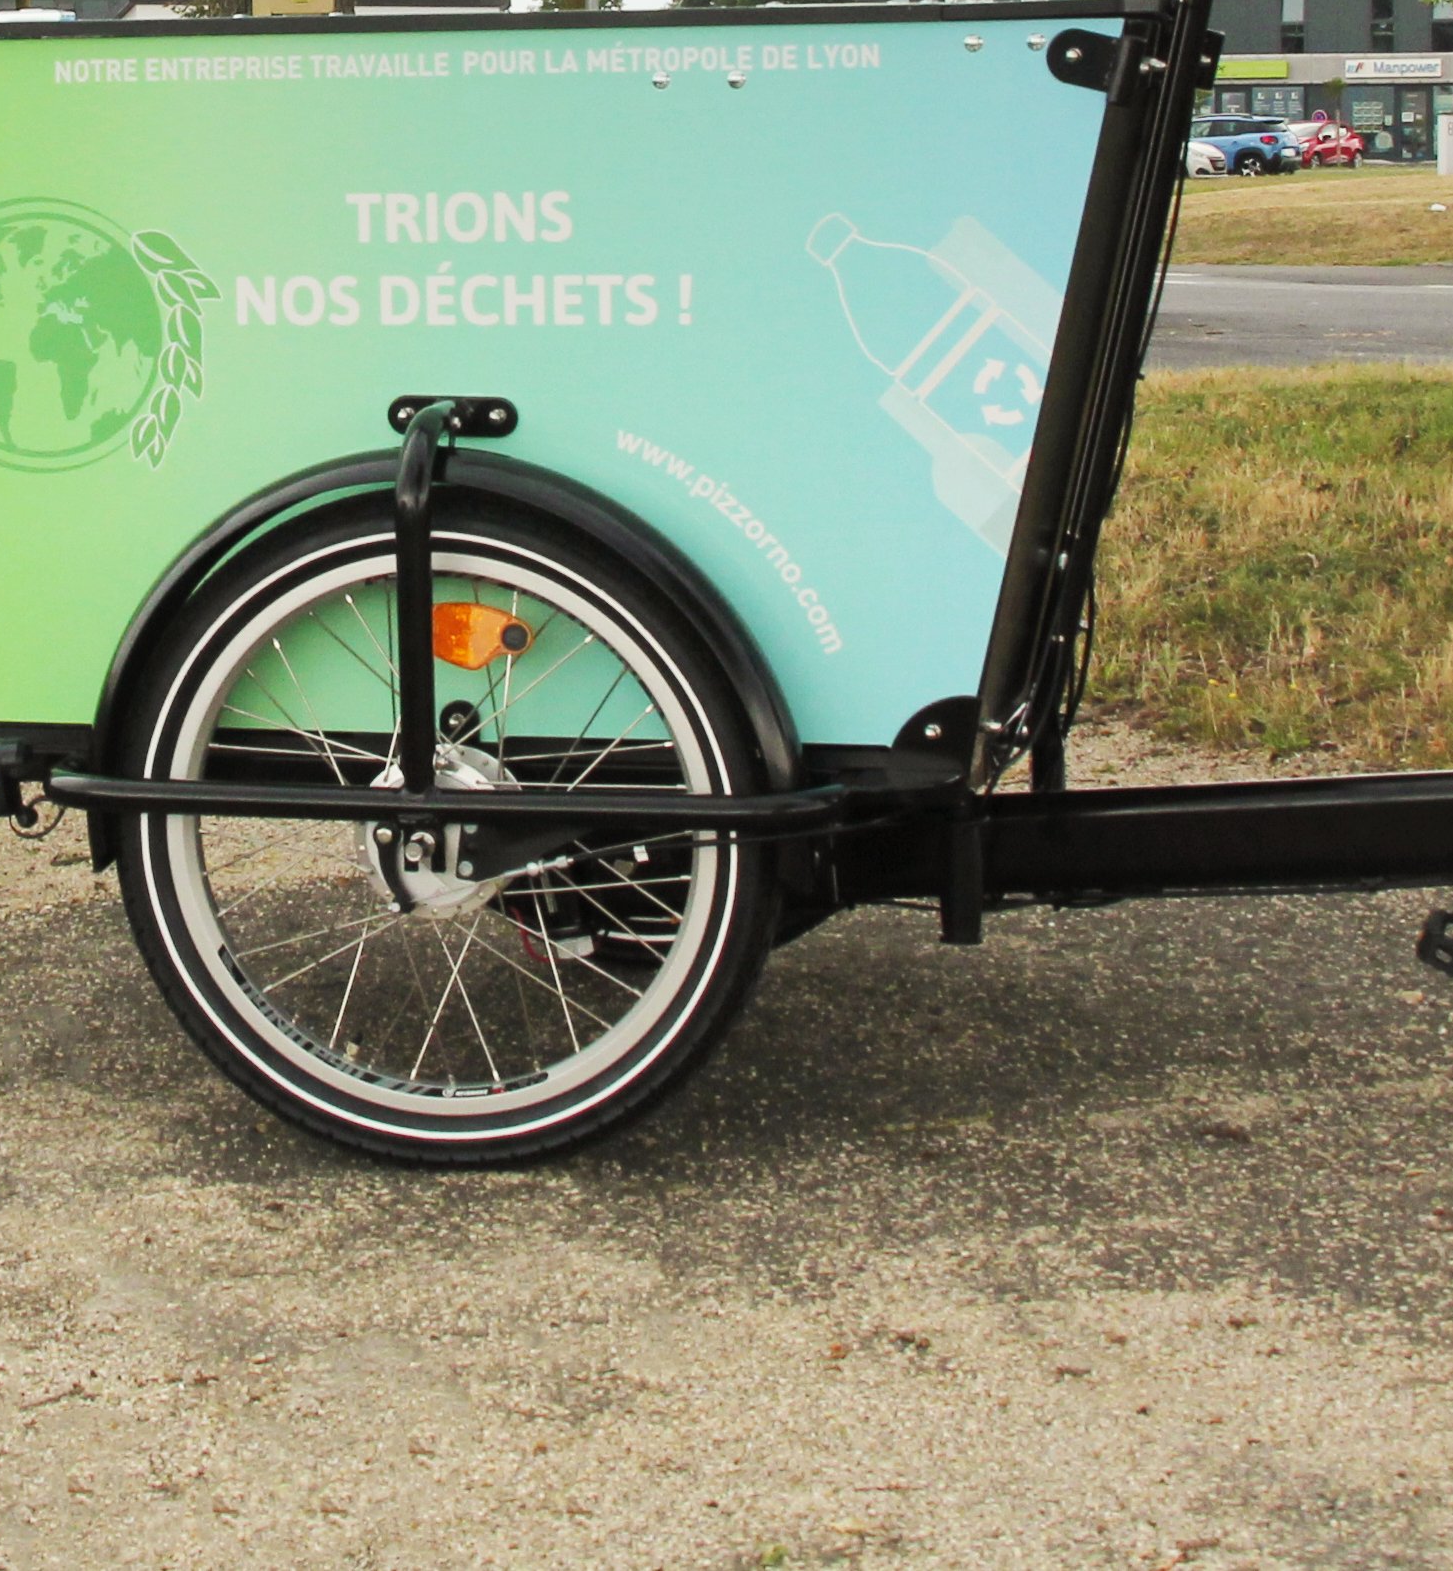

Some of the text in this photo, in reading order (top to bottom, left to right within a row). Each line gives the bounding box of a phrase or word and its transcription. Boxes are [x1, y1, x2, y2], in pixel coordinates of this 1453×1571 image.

[54, 41, 880, 83] NOTRE ENTREPRISE TRAVAILLE POUR LA MÉTROPOLE DE LYON
[1373, 61, 1439, 76] Manpower
[345, 191, 574, 244] TRIONS
[235, 261, 694, 327] NOS DÉCHETS !
[615, 430, 845, 655] www.pizzorno.com
